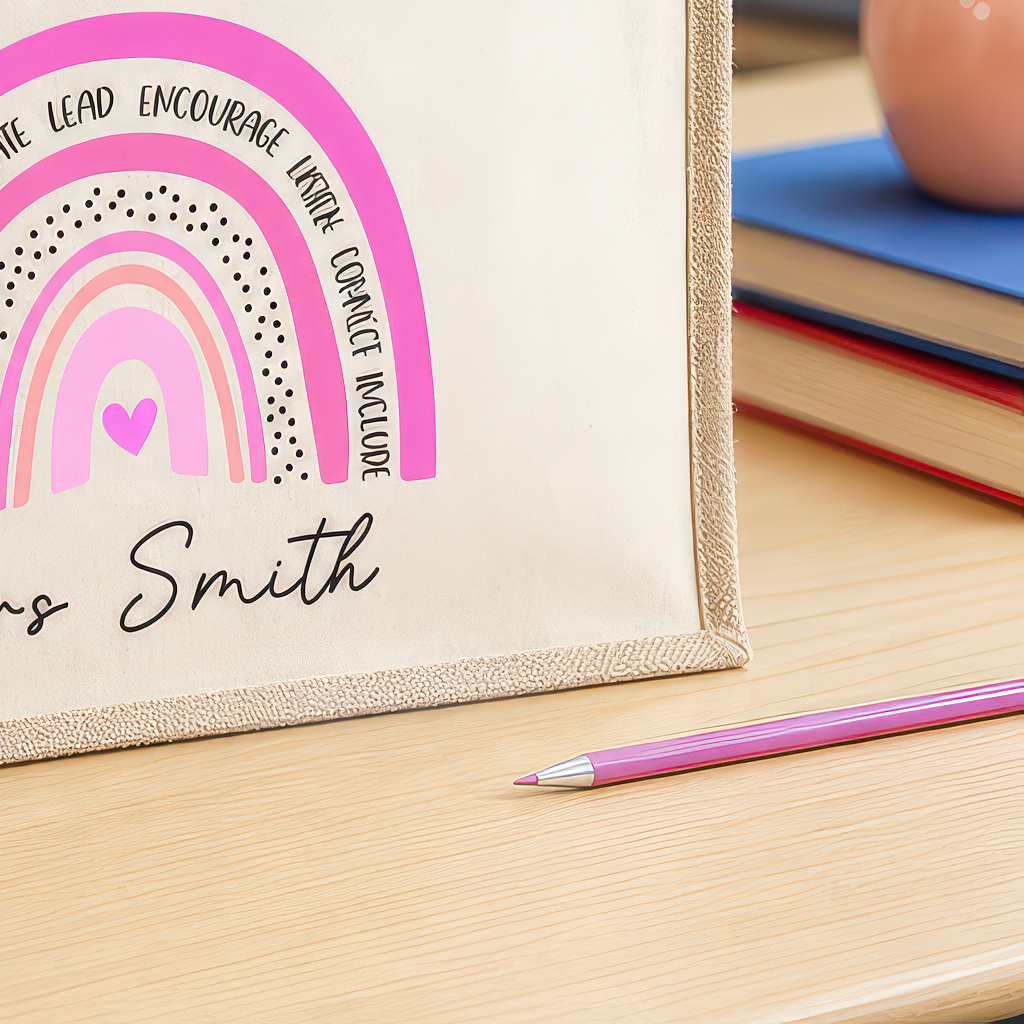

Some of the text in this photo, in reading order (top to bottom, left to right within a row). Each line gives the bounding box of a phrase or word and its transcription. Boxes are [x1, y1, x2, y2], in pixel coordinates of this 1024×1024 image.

[47, 86, 114, 133] LEAD
[139, 85, 290, 158] ENCOURAGE
[355, 371, 391, 482] INCLUDE
[119, 512, 380, 633] Smith
